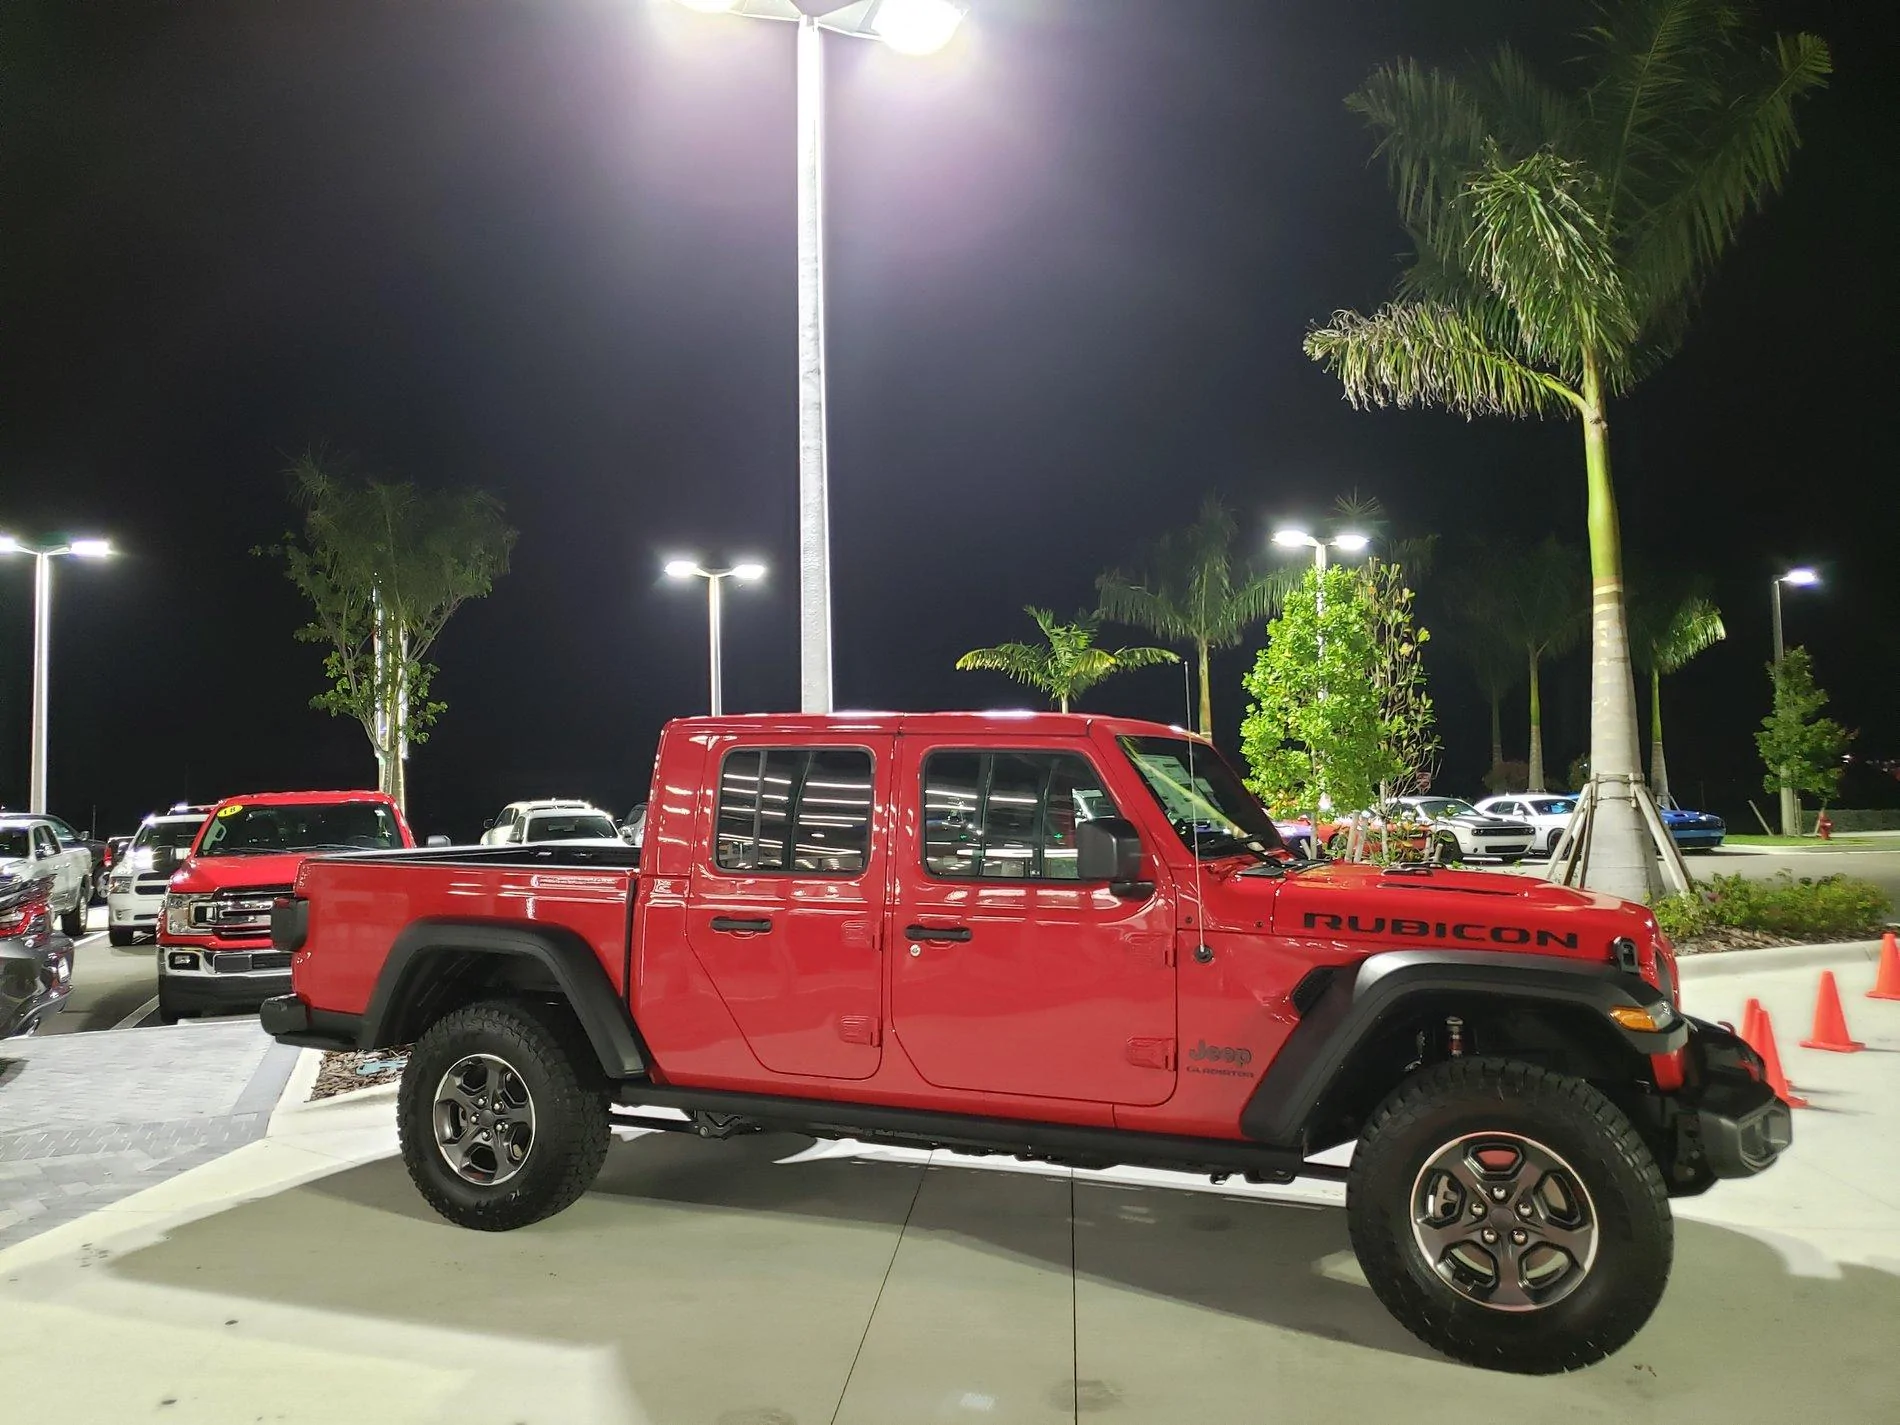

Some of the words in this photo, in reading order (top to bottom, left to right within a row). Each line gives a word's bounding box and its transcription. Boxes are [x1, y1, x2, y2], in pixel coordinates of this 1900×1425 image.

[1303, 912, 1578, 949] RUBICON
[1189, 1039, 1252, 1067] Jeep
[1186, 1066, 1254, 1078] GLADIATOR
